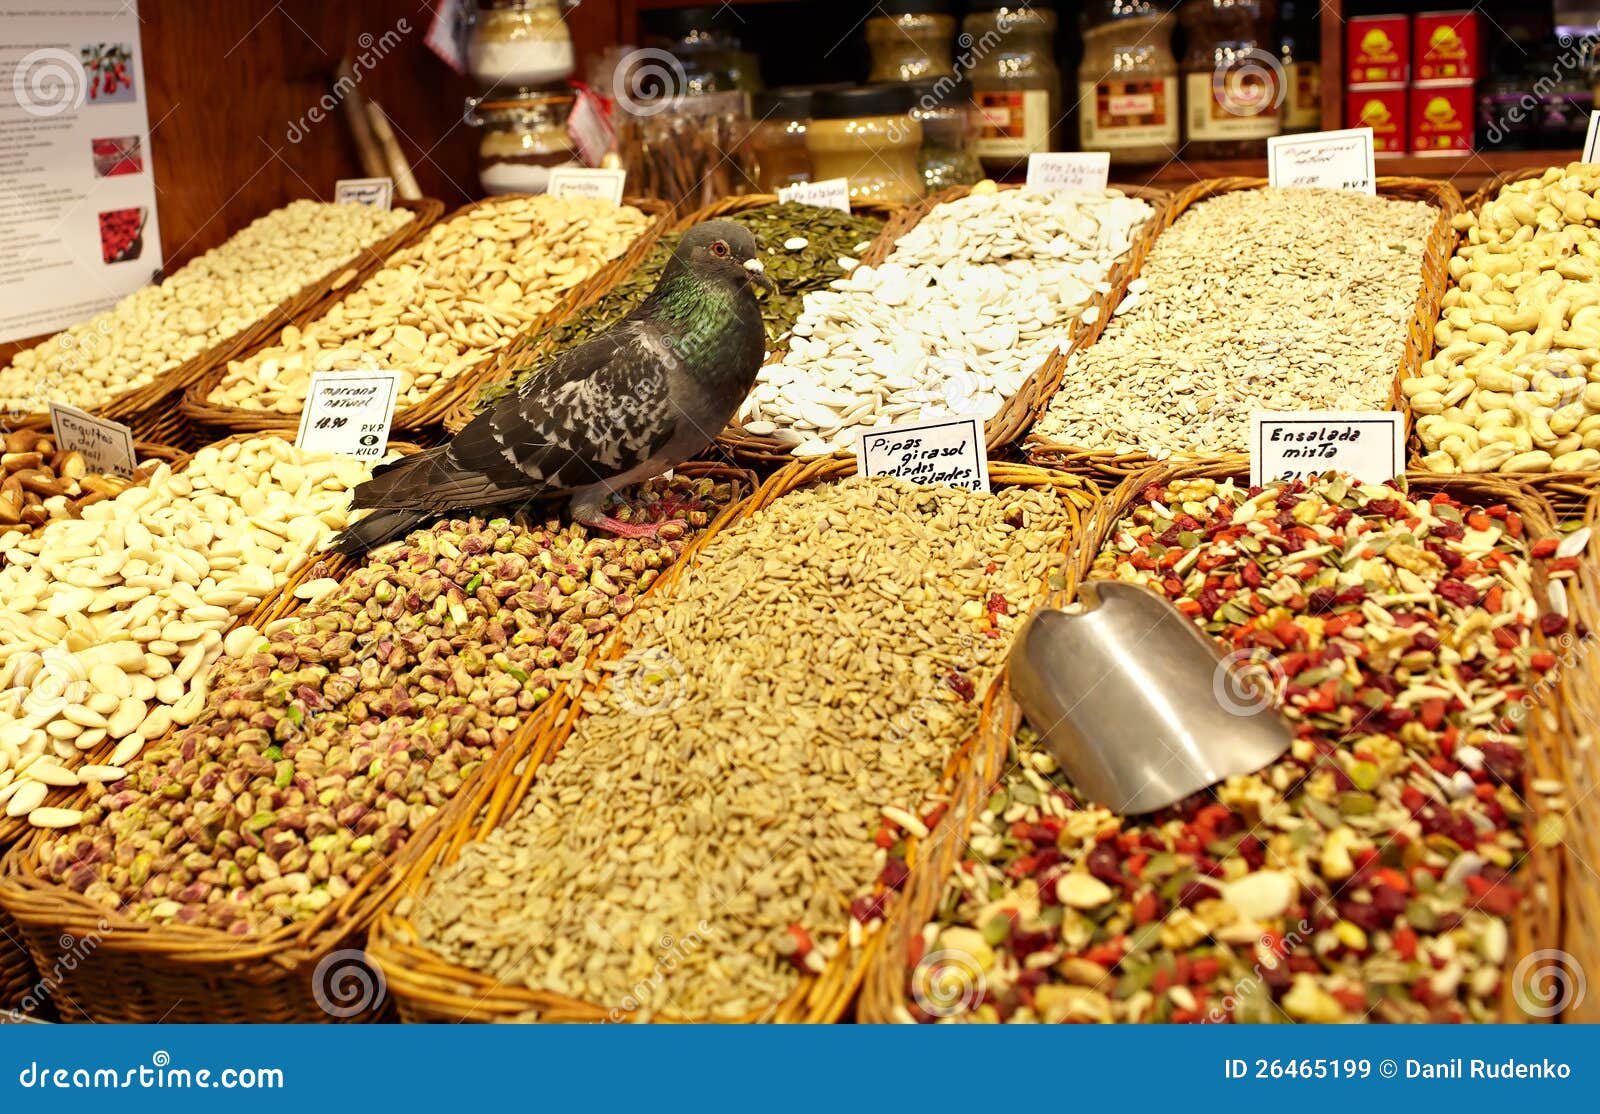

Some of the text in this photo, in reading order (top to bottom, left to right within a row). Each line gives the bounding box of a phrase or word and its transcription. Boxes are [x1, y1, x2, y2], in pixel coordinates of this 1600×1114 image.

[1270, 426, 1361, 442] Ensalada
[355, 448, 379, 456] KILO
[870, 438, 922, 456] Pipas
[901, 440, 966, 467] girasol
